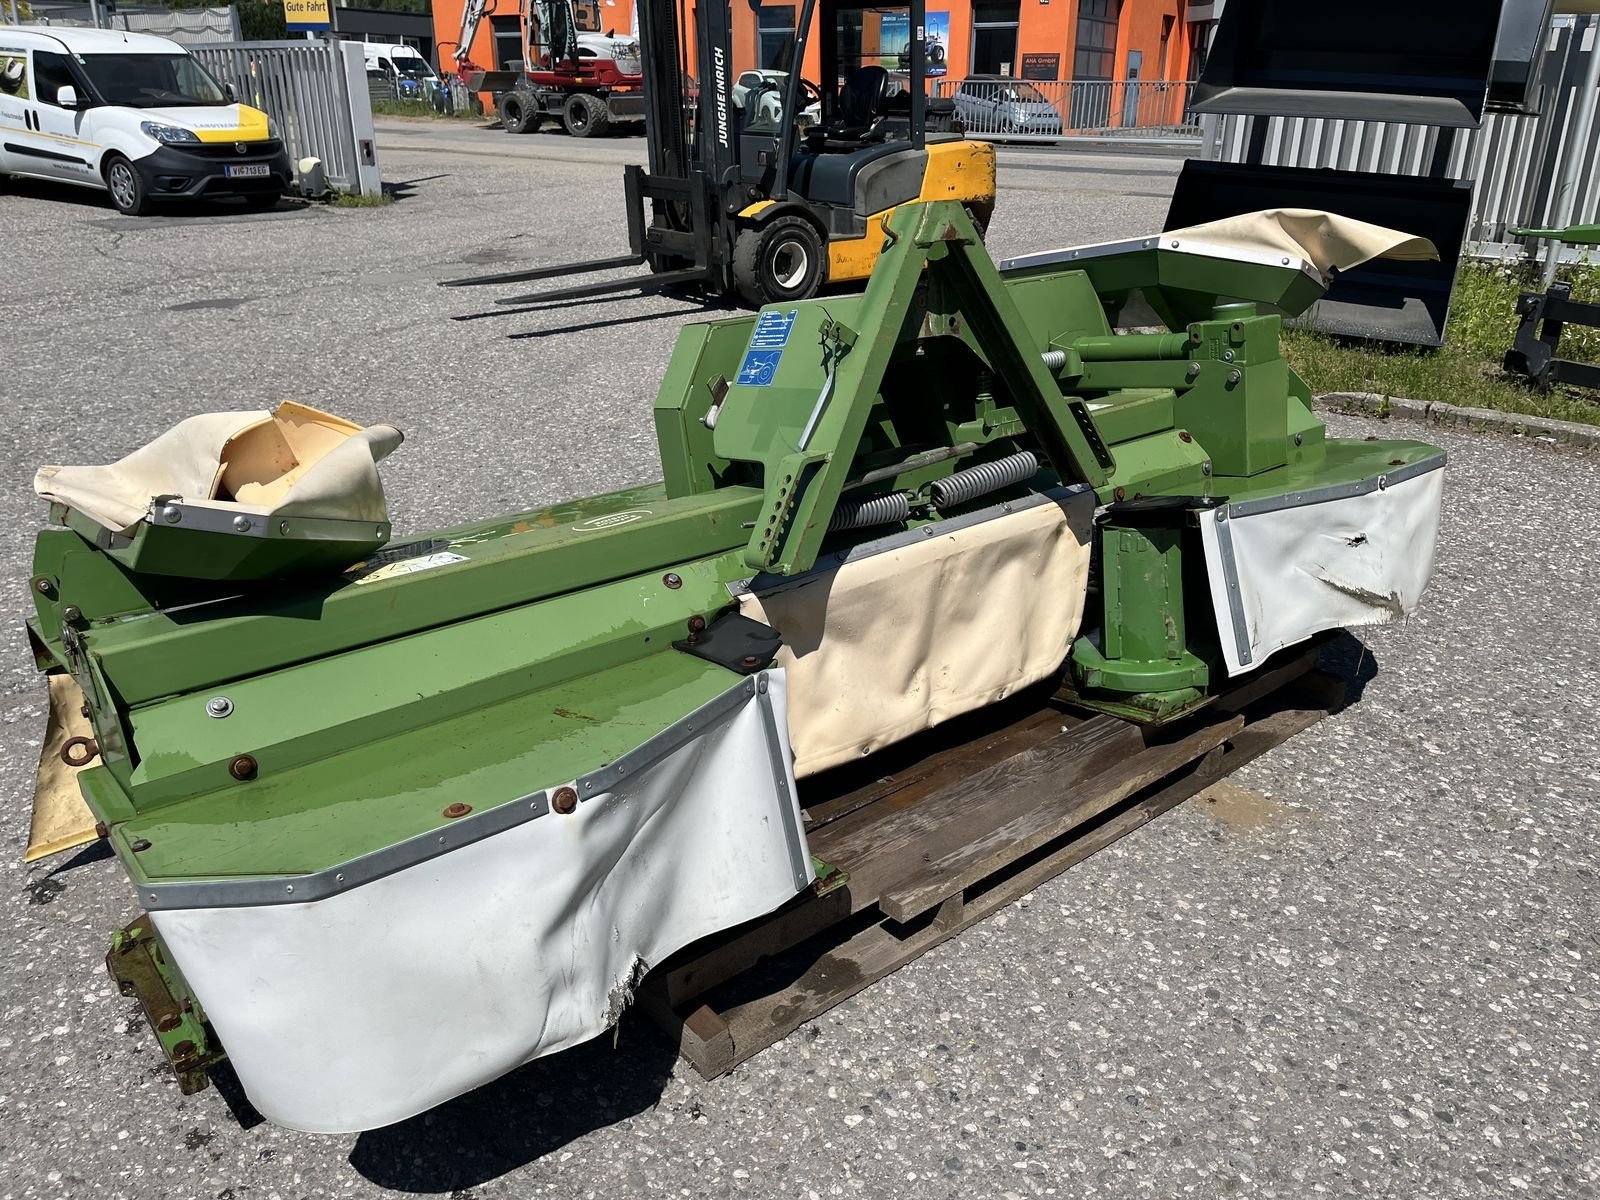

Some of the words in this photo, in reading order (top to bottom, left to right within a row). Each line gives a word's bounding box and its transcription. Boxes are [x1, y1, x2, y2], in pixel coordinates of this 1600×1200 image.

[286, 2, 304, 12] Gute
[306, 1, 326, 12] Fahrt
[714, 46, 728, 148] JUNGHEINRICH
